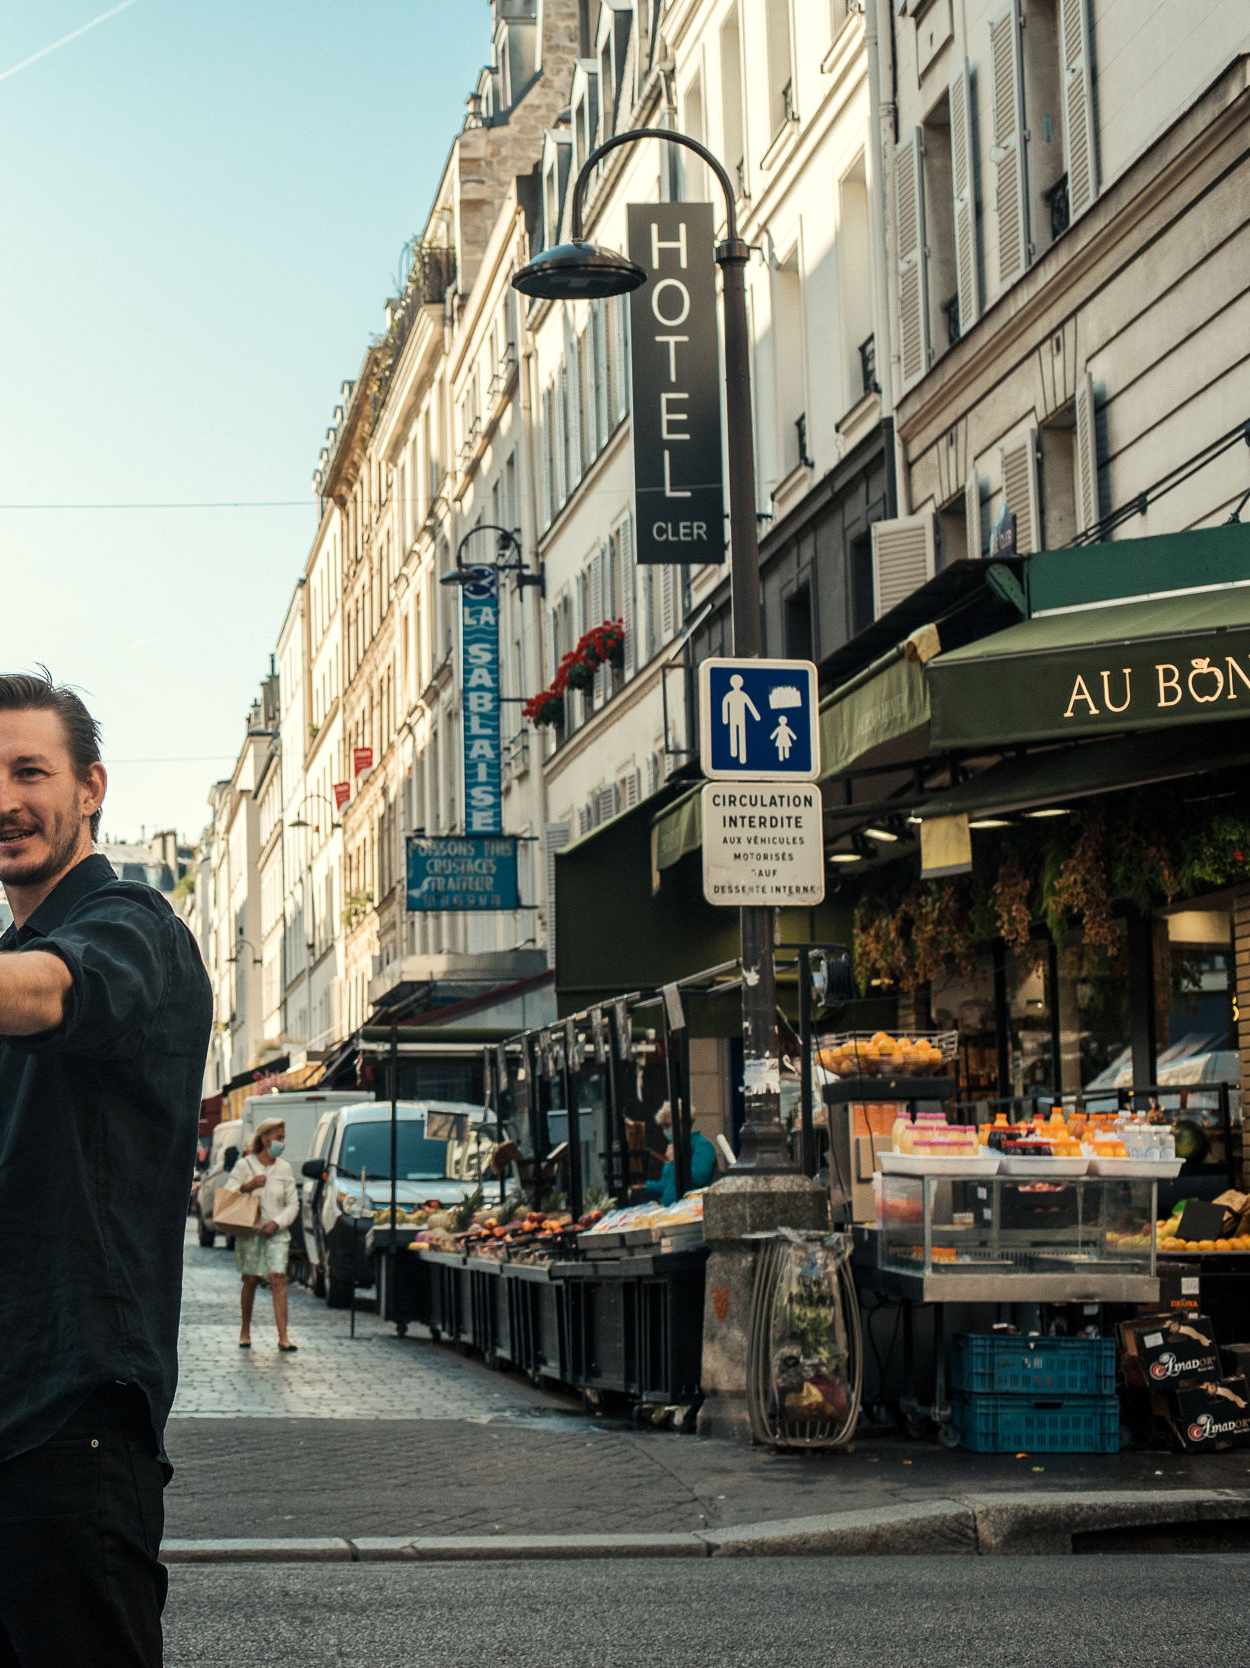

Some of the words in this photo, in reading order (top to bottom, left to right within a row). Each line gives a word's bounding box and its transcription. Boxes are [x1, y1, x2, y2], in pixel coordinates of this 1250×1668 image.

[650, 222, 692, 498] HOTEL
[652, 521, 708, 542] CLER
[464, 606, 496, 625] LA
[1063, 667, 1132, 717] AU
[468, 643, 496, 832] SABLAISE
[712, 794, 813, 808] CIRCULATION
[722, 815, 803, 829] INTERDITE
[722, 836, 742, 845] AUX
